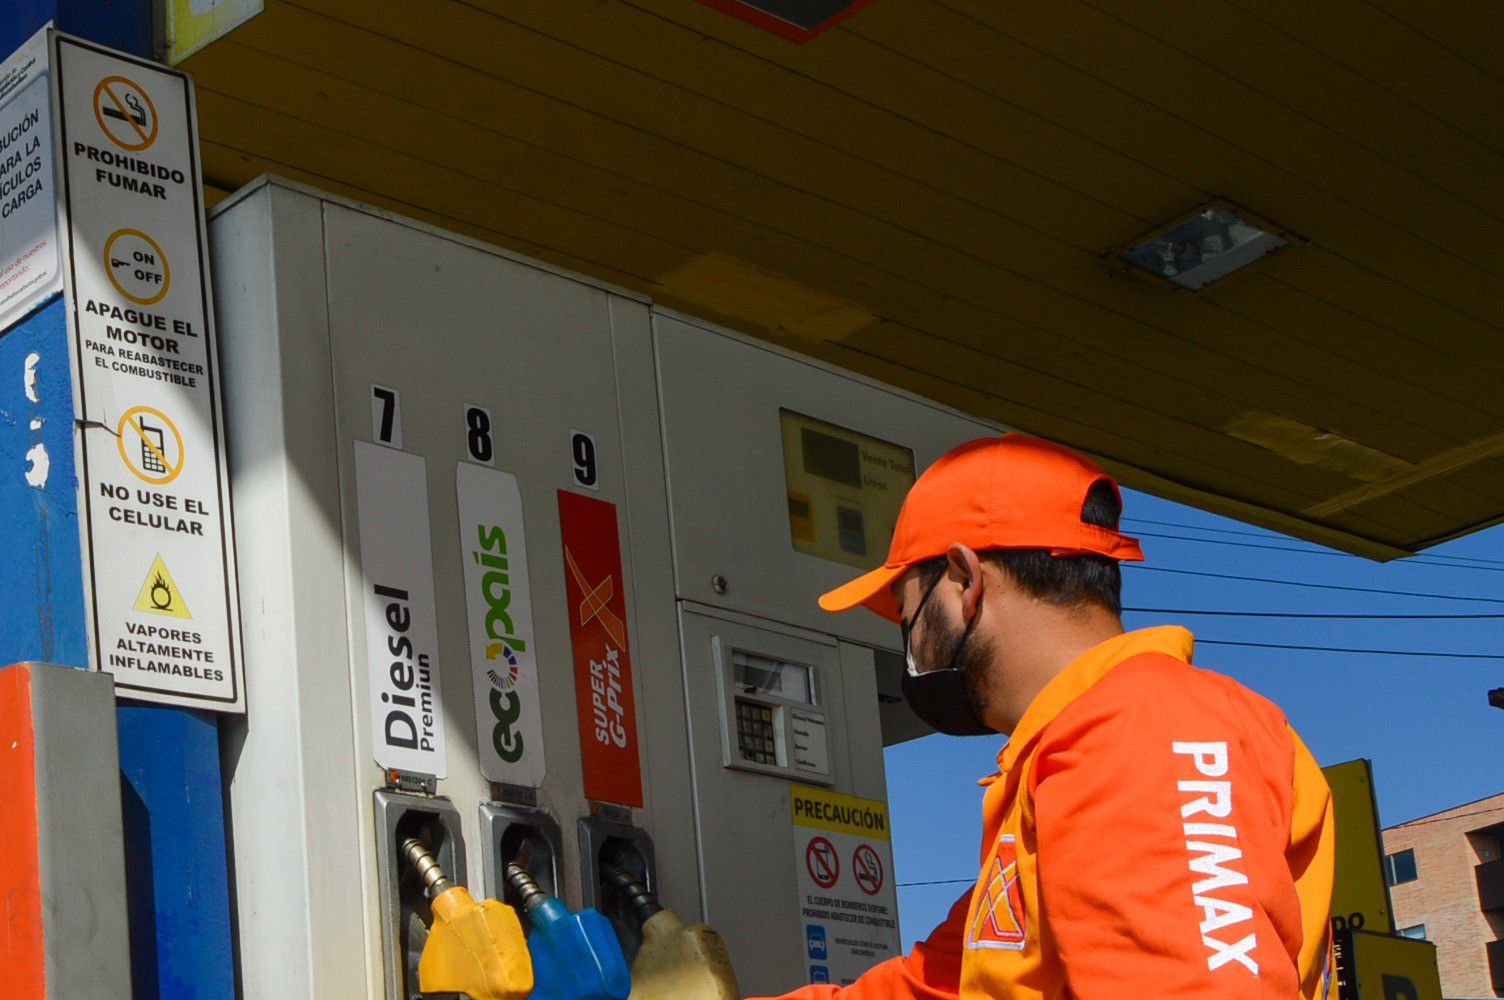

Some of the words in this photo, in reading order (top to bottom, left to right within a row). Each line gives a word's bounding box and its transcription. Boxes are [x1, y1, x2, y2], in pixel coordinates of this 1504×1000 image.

[26, 136, 41, 157] LA
[74, 141, 185, 184] PROHIBIDO
[2, 179, 43, 219] CARGA
[96, 168, 167, 200] FUMAR
[132, 251, 155, 265] ON
[134, 269, 163, 285] OFF
[85, 299, 166, 331] APAGUE
[173, 320, 198, 338] EL
[106, 325, 180, 354] MOTOR
[85, 340, 115, 357] PARA
[119, 347, 204, 376] REABASTECER
[95, 357, 109, 369] EL
[112, 360, 197, 388] COMBUSTIBLE
[373, 386, 396, 443] 7
[465, 407, 493, 462] 8
[572, 432, 597, 486] 9
[100, 482, 130, 501] NO
[137, 489, 178, 510] USE
[184, 499, 210, 516] EL
[109, 506, 204, 536] CELULAR
[125, 621, 202, 644] VAPORES
[116, 638, 214, 663] ALTAMENTE
[373, 583, 420, 751] Diesel
[109, 654, 224, 682] INFLAMABLES
[420, 653, 436, 753] Premiun
[590, 658, 610, 745] SUPER
[605, 643, 627, 749] G-Prix
[794, 797, 885, 831] PRECAUCIÓN
[1172, 741, 1259, 978] PRIMAX
[1331, 912, 1364, 932] DO
